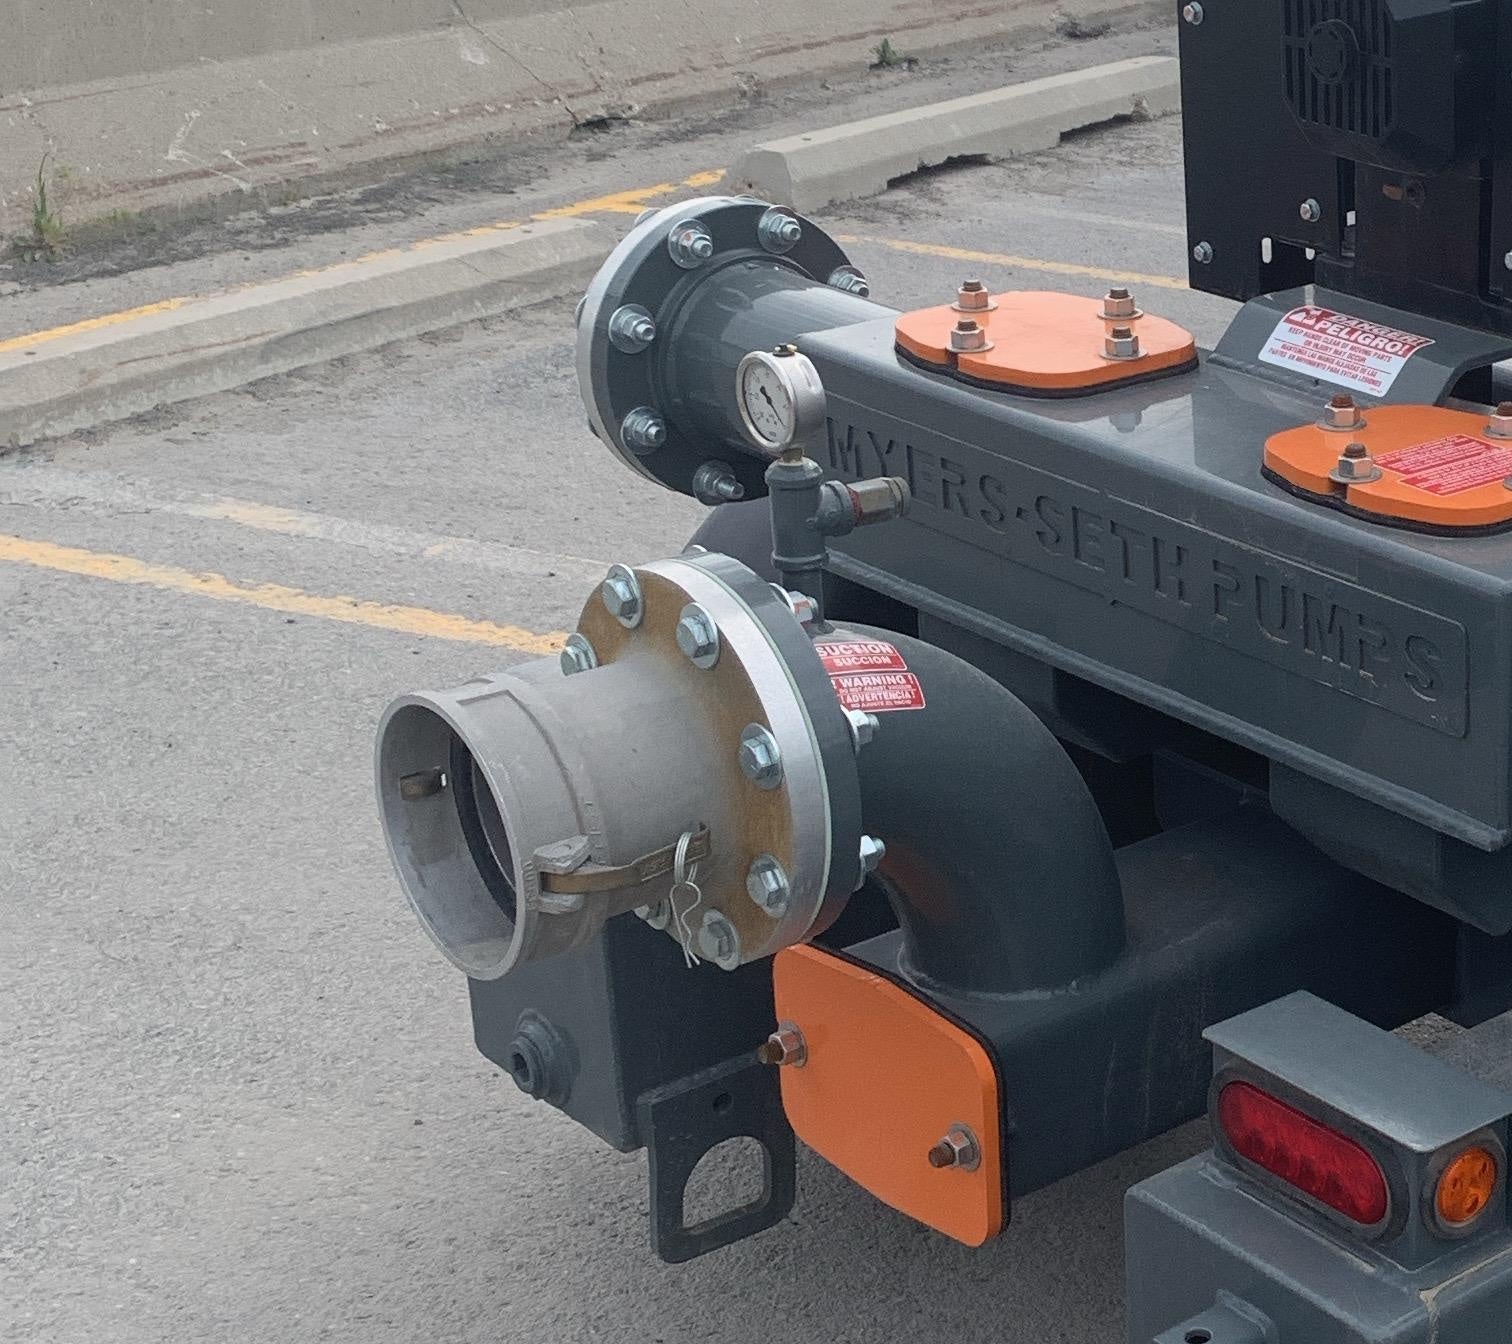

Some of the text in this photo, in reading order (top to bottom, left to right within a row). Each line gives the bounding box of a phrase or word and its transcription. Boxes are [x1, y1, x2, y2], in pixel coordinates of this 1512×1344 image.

[1313, 320, 1410, 356] PELIGRO!
[1373, 349, 1393, 363] PARTS
[1212, 559, 1446, 703] PUMPS
[816, 642, 895, 657] SUCTION
[832, 656, 892, 667] SUCCION
[839, 675, 907, 688] WARNING
[846, 691, 912, 704] ADVERTENCIA
